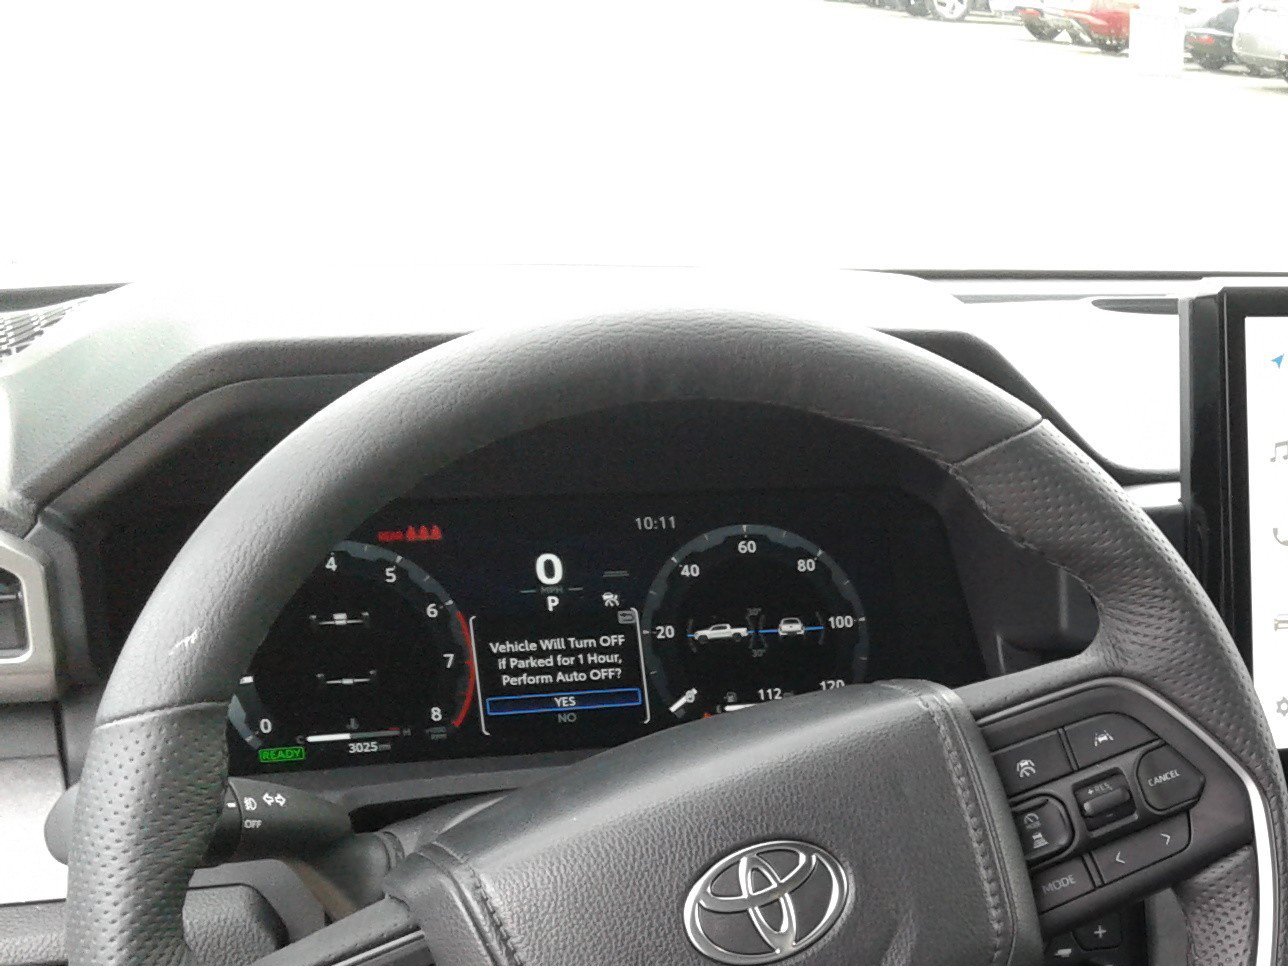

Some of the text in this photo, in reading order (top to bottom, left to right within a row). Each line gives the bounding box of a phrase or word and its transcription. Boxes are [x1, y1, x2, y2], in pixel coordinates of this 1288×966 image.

[635, 515, 676, 531] 10:11
[737, 540, 757, 554] 60
[325, 556, 338, 572] 4
[680, 564, 700, 578] 40
[797, 558, 816, 572] 80
[385, 567, 397, 583] 5
[426, 603, 438, 618] 6
[546, 596, 560, 612] P
[828, 615, 854, 629] 100
[655, 625, 675, 639] 20
[489, 634, 626, 654] Vehicle Will Turn OFF
[443, 653, 455, 669] 7
[509, 654, 554, 669] Parked
[557, 653, 576, 666] for
[577, 653, 584, 665] 1
[502, 667, 622, 687] Perform Auto OFF?
[758, 687, 783, 701] 112
[553, 696, 577, 708] YES
[430, 706, 443, 721] 8
[557, 713, 578, 724] NO
[259, 718, 272, 733] 0
[348, 741, 379, 754] 3025
[261, 750, 302, 761] READY
[1147, 769, 1180, 787] CANCEL
[1042, 874, 1077, 894] MODE
